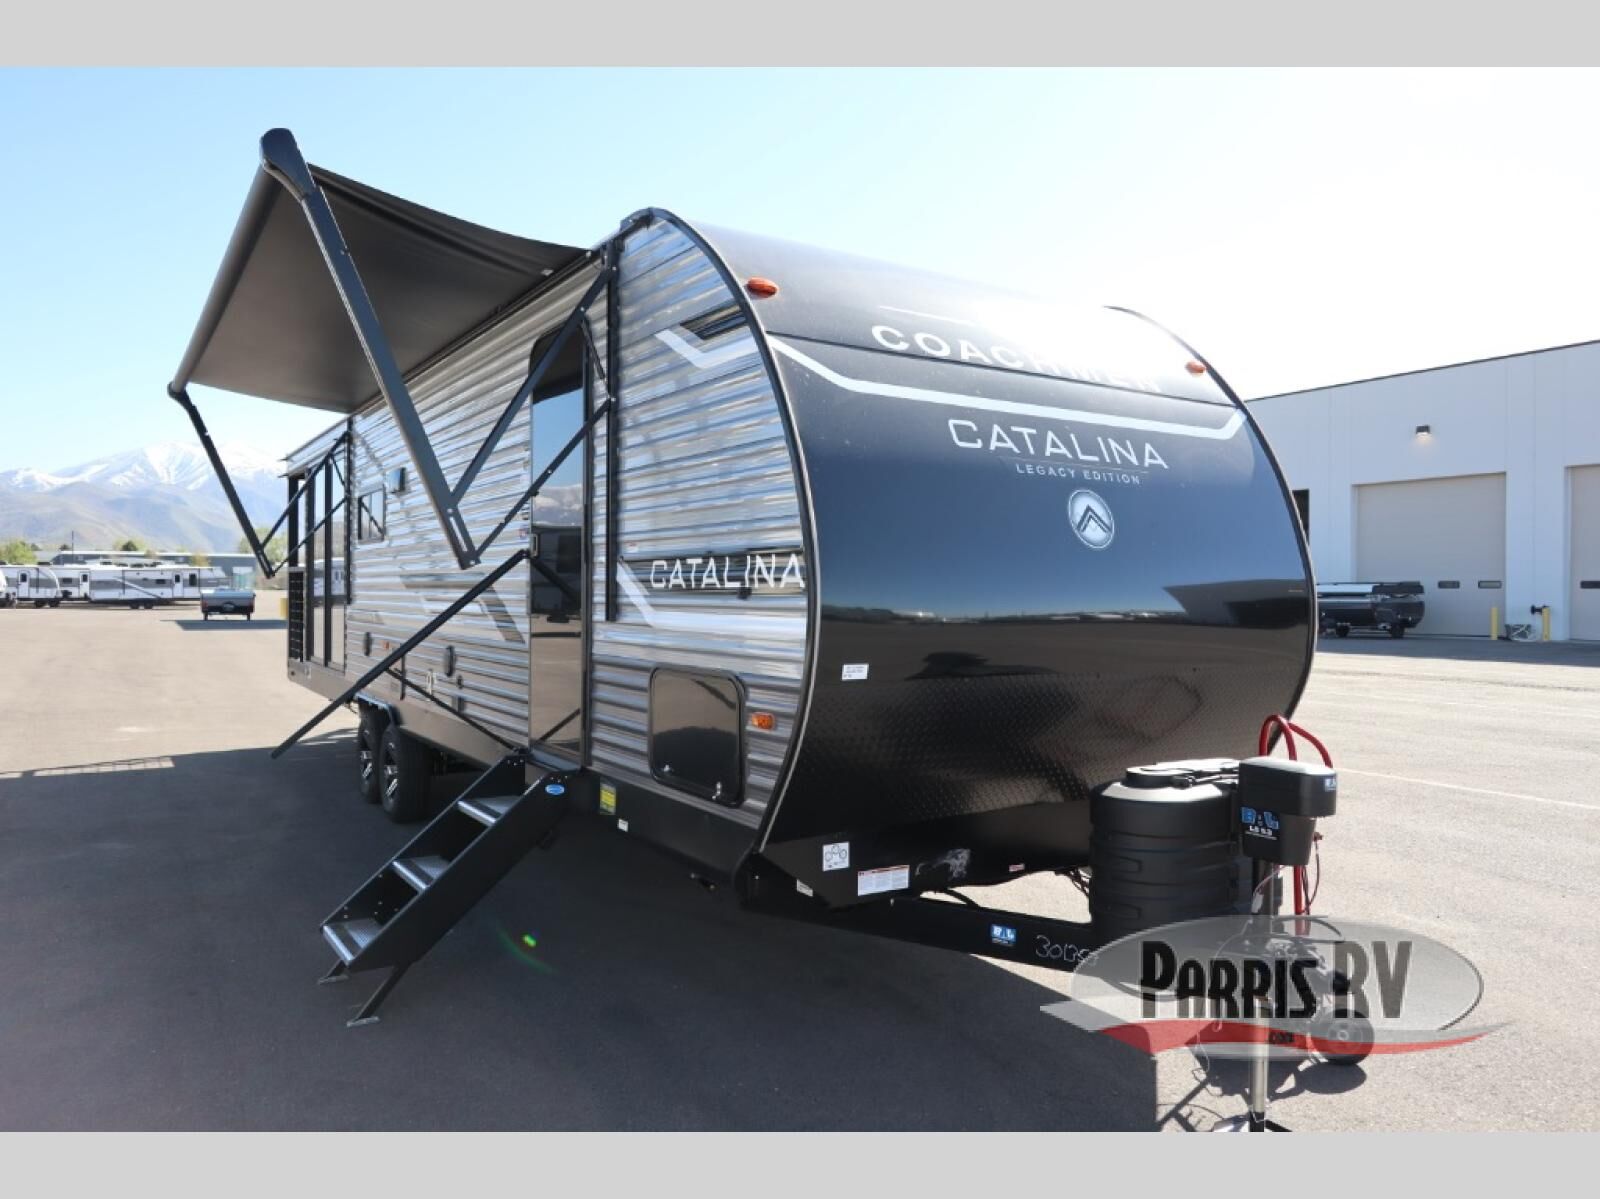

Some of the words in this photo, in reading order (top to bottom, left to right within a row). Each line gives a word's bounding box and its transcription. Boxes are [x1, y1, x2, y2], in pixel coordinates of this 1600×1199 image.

[948, 418, 1169, 470] CATALINA
[1015, 463, 1076, 479] LEGACY
[1082, 469, 1141, 485] EDITION
[650, 553, 806, 590] CATALINA
